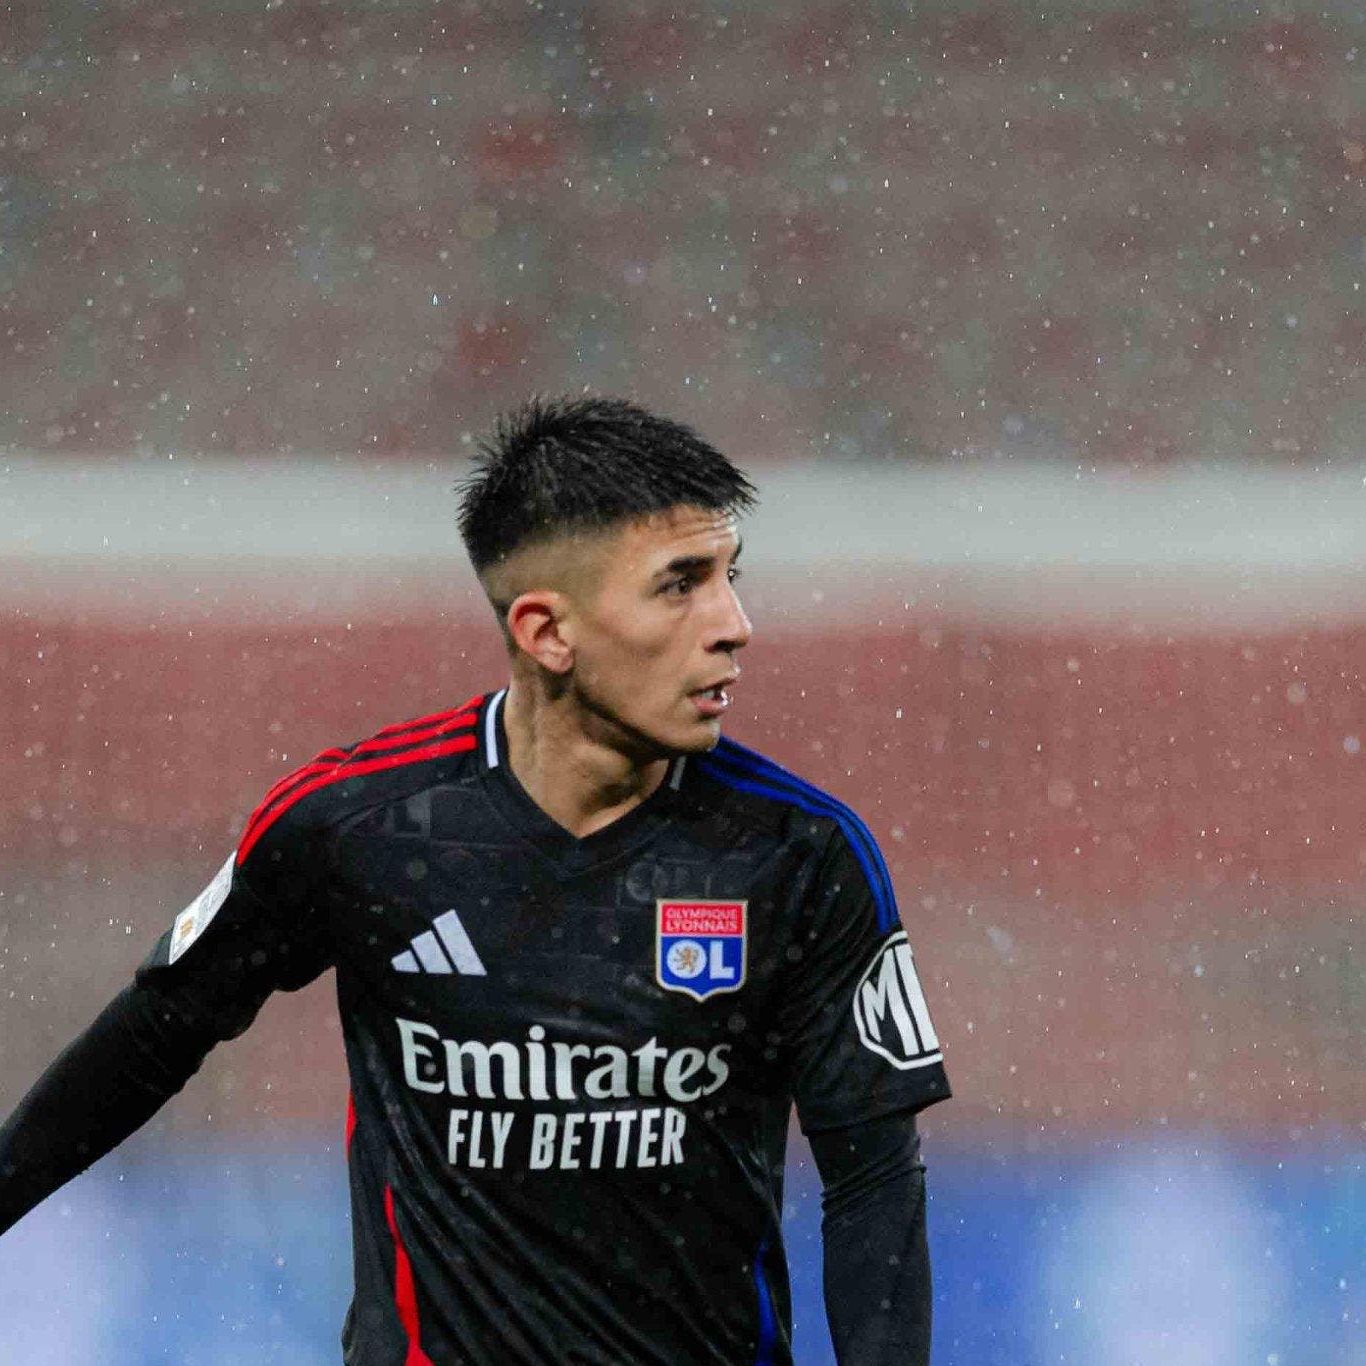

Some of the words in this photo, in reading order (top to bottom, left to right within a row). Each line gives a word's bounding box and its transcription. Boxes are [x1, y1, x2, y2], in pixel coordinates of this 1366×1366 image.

[665, 907, 738, 919] OLYMPIQUE
[665, 919, 738, 932] LYONNAIS
[666, 939, 735, 980] OL
[395, 1017, 733, 1103] Emirates
[448, 1109, 515, 1169] FLY
[529, 1107, 687, 1171] BETTER
